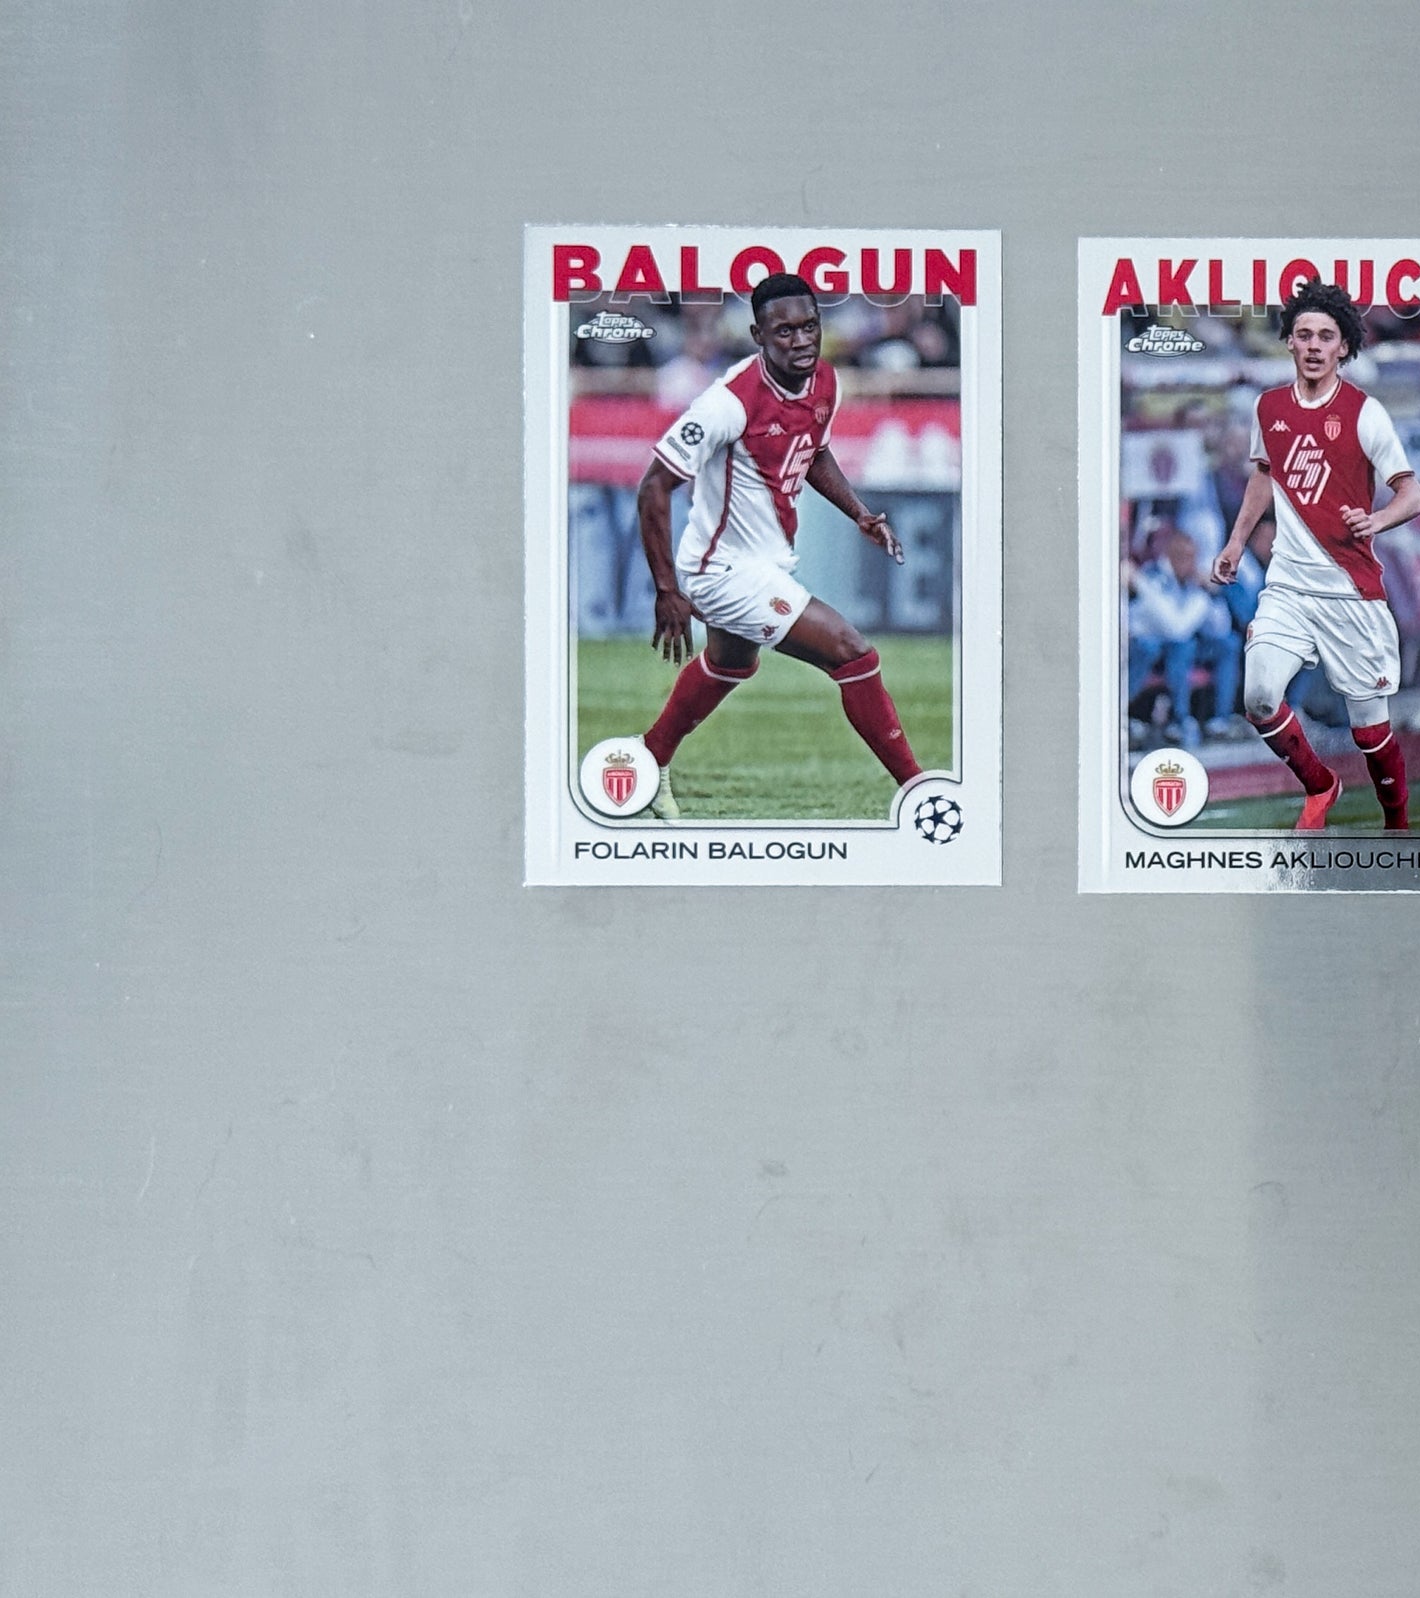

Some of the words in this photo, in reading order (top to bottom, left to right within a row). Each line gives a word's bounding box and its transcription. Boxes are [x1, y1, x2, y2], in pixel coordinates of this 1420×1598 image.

[552, 244, 977, 307] BALOGUN
[577, 324, 654, 339] Chrome
[1128, 337, 1203, 352] Chrome
[574, 841, 699, 860] FOLARIN
[708, 841, 848, 860] BALOGUN
[1125, 850, 1263, 869] MAGHNES
